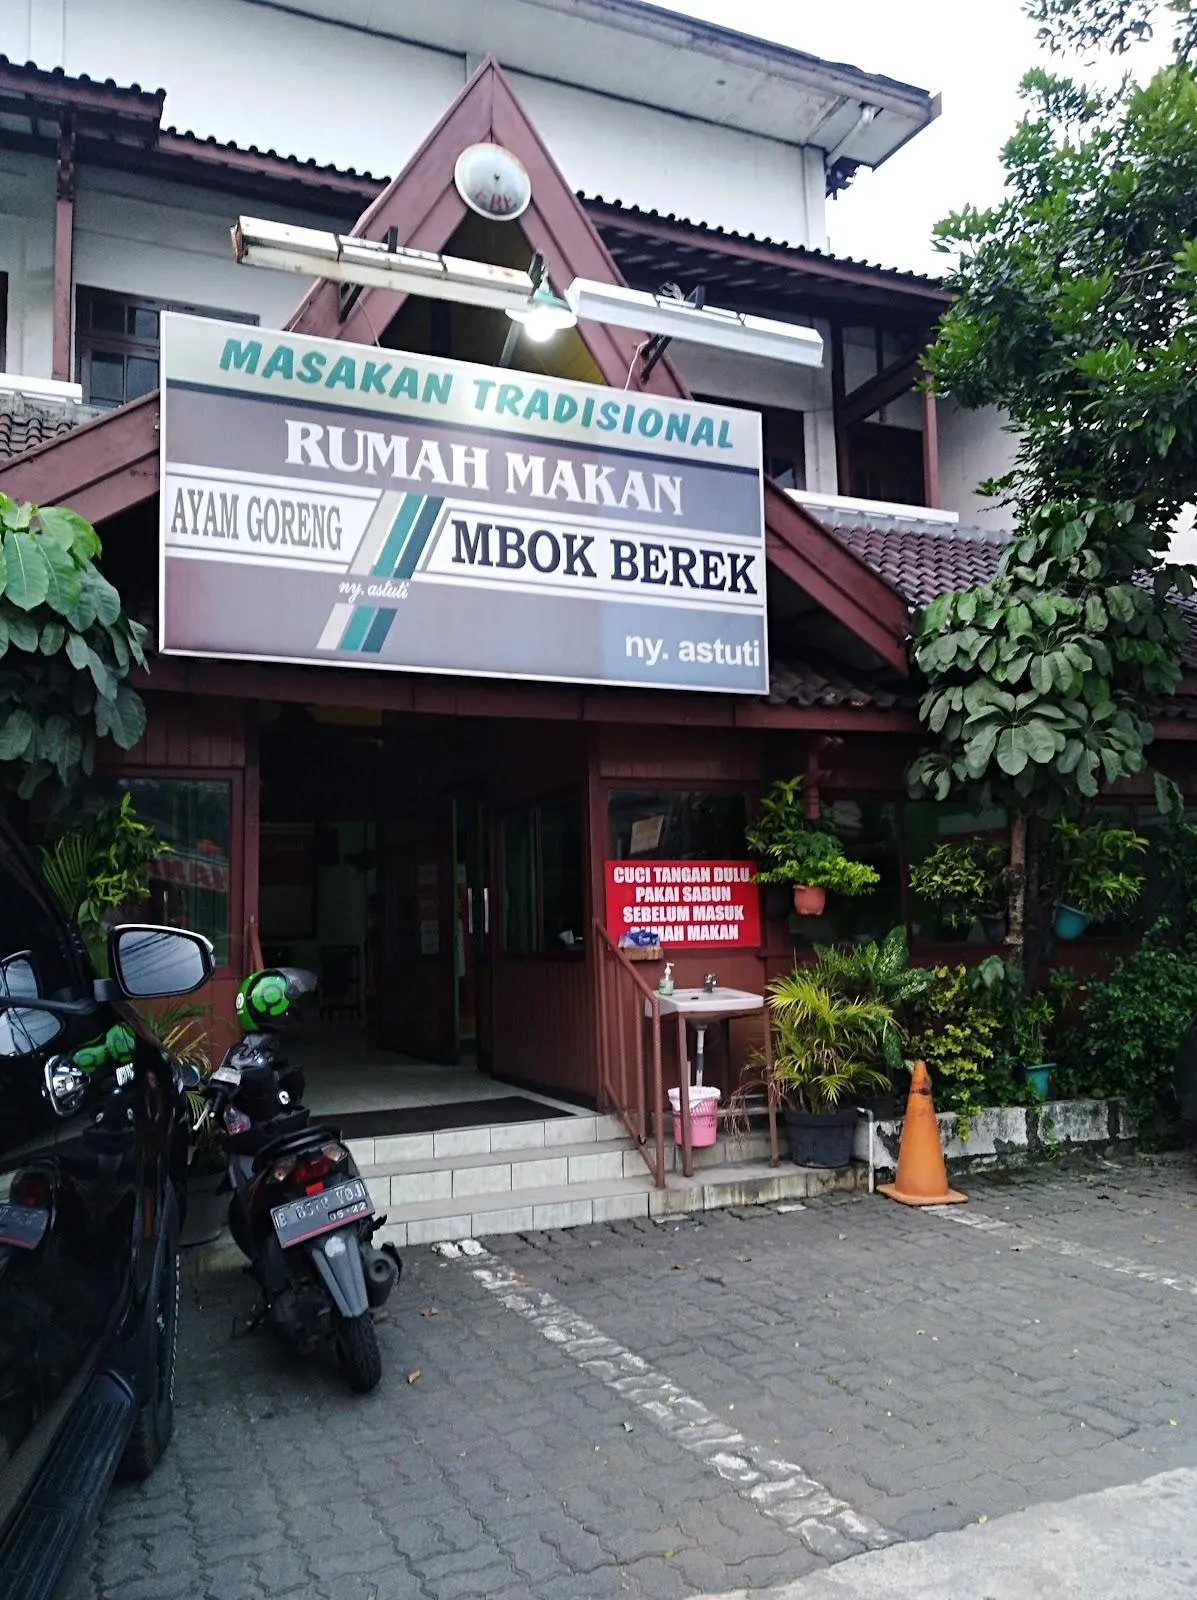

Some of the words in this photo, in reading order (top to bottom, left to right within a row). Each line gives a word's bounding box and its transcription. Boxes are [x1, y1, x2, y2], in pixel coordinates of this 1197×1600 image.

[219, 338, 454, 405] MASAKAN
[473, 379, 733, 449] TRADISIONAL
[284, 418, 490, 491] RUMAH
[505, 451, 684, 517] MAKAN
[171, 487, 240, 540] AYAM
[246, 496, 342, 551] GORENG
[451, 519, 597, 579] MBOK
[610, 538, 758, 596] BEREK
[367, 580, 410, 600] astuti
[625, 635, 669, 666] ny.
[678, 638, 760, 667] astuti
[613, 866, 651, 884] CUCI
[653, 866, 711, 883] TANGAN
[713, 866, 750, 883] DULU
[635, 886, 680, 903] PAKAI
[682, 886, 732, 902] SABUN
[622, 905, 690, 923] SEBELUM
[692, 904, 745, 921] MASUK
[630, 925, 685, 942] MAH
[687, 924, 739, 942] MAKAN
